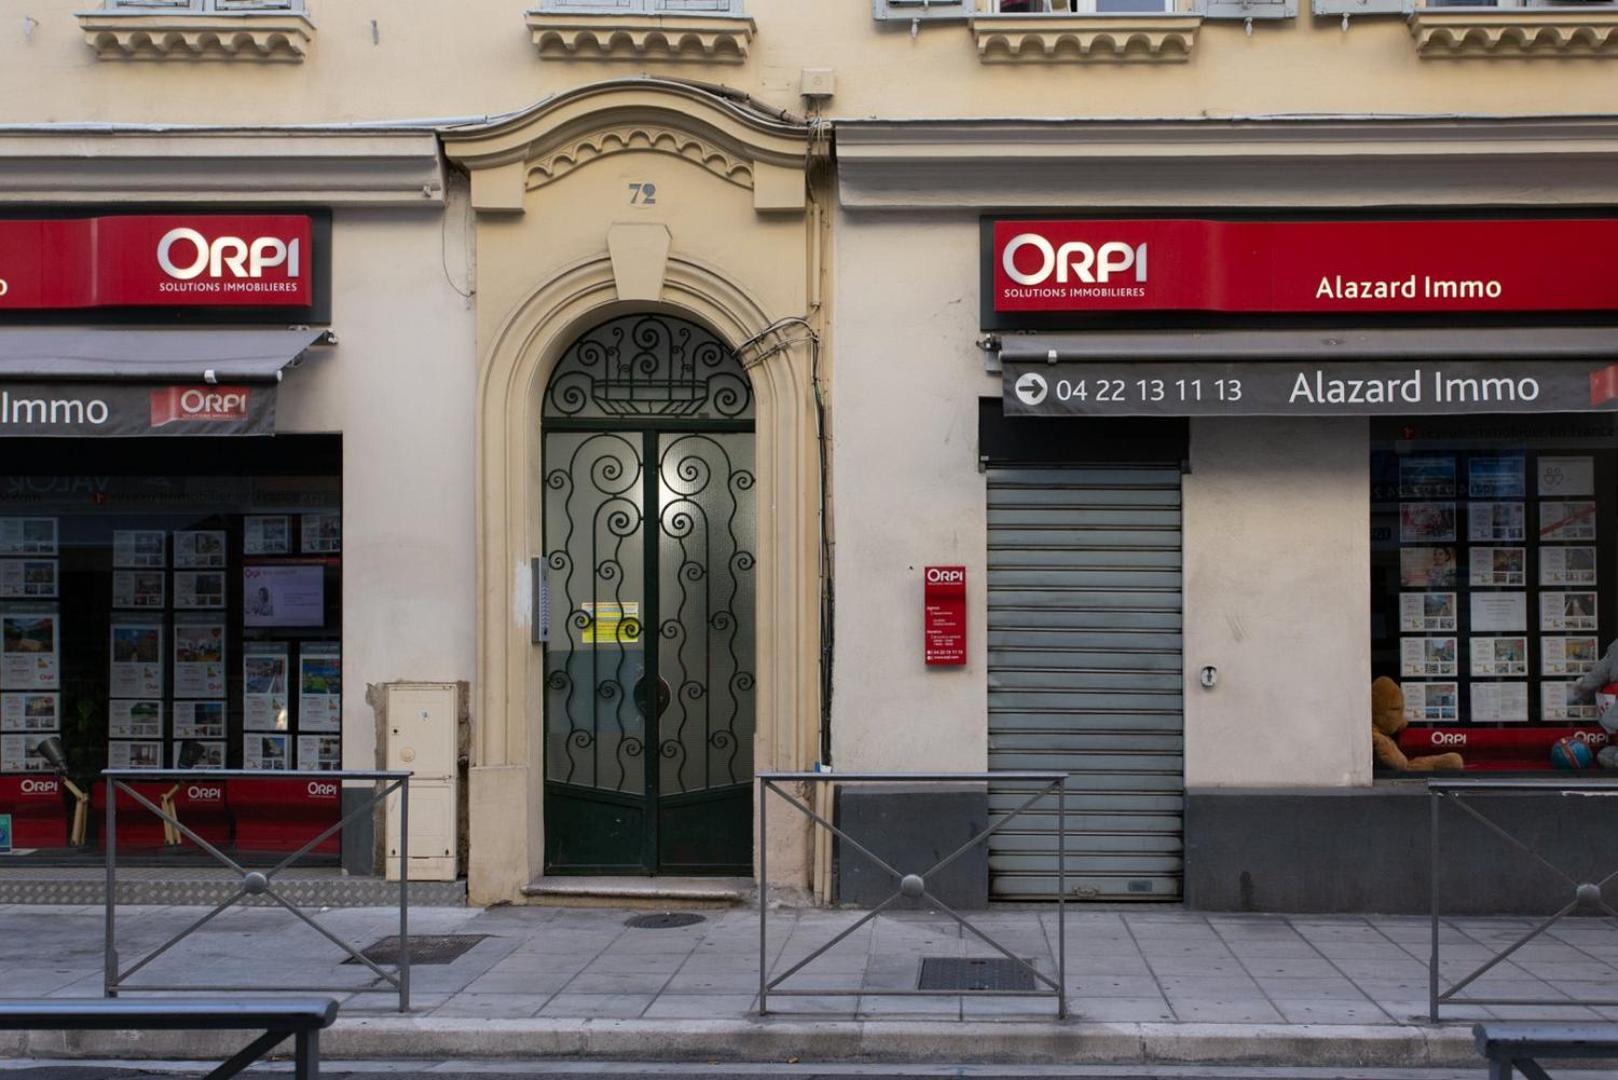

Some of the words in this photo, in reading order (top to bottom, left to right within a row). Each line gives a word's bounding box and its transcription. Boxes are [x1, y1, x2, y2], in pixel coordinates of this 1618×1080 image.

[627, 183, 656, 204] 72
[157, 227, 299, 280] ORPI
[1002, 233, 1147, 286] ORPI
[159, 282, 220, 292] SOLUTIONS
[223, 282, 297, 292] IMMOBILIERES
[1004, 288, 1066, 298] SOLUTIONS
[1069, 287, 1145, 297] IMMOBILIERES
[1315, 275, 1416, 299] Alazard
[1424, 276, 1502, 298] Immo
[1056, 380, 1088, 401] 04
[1096, 380, 1126, 401] 22
[1136, 379, 1165, 401] 13
[1176, 379, 1201, 400] 11
[1214, 379, 1242, 401] 13
[1289, 369, 1421, 403] Alazard
[1436, 371, 1540, 402] Immo
[2, 391, 108, 424] Immo
[181, 389, 246, 413] ORPI
[927, 568, 963, 582] ORPI
[1431, 731, 1467, 744] ORPI
[20, 779, 58, 793] ORPI
[187, 786, 221, 799] ORPI
[307, 782, 337, 795] ORPI
